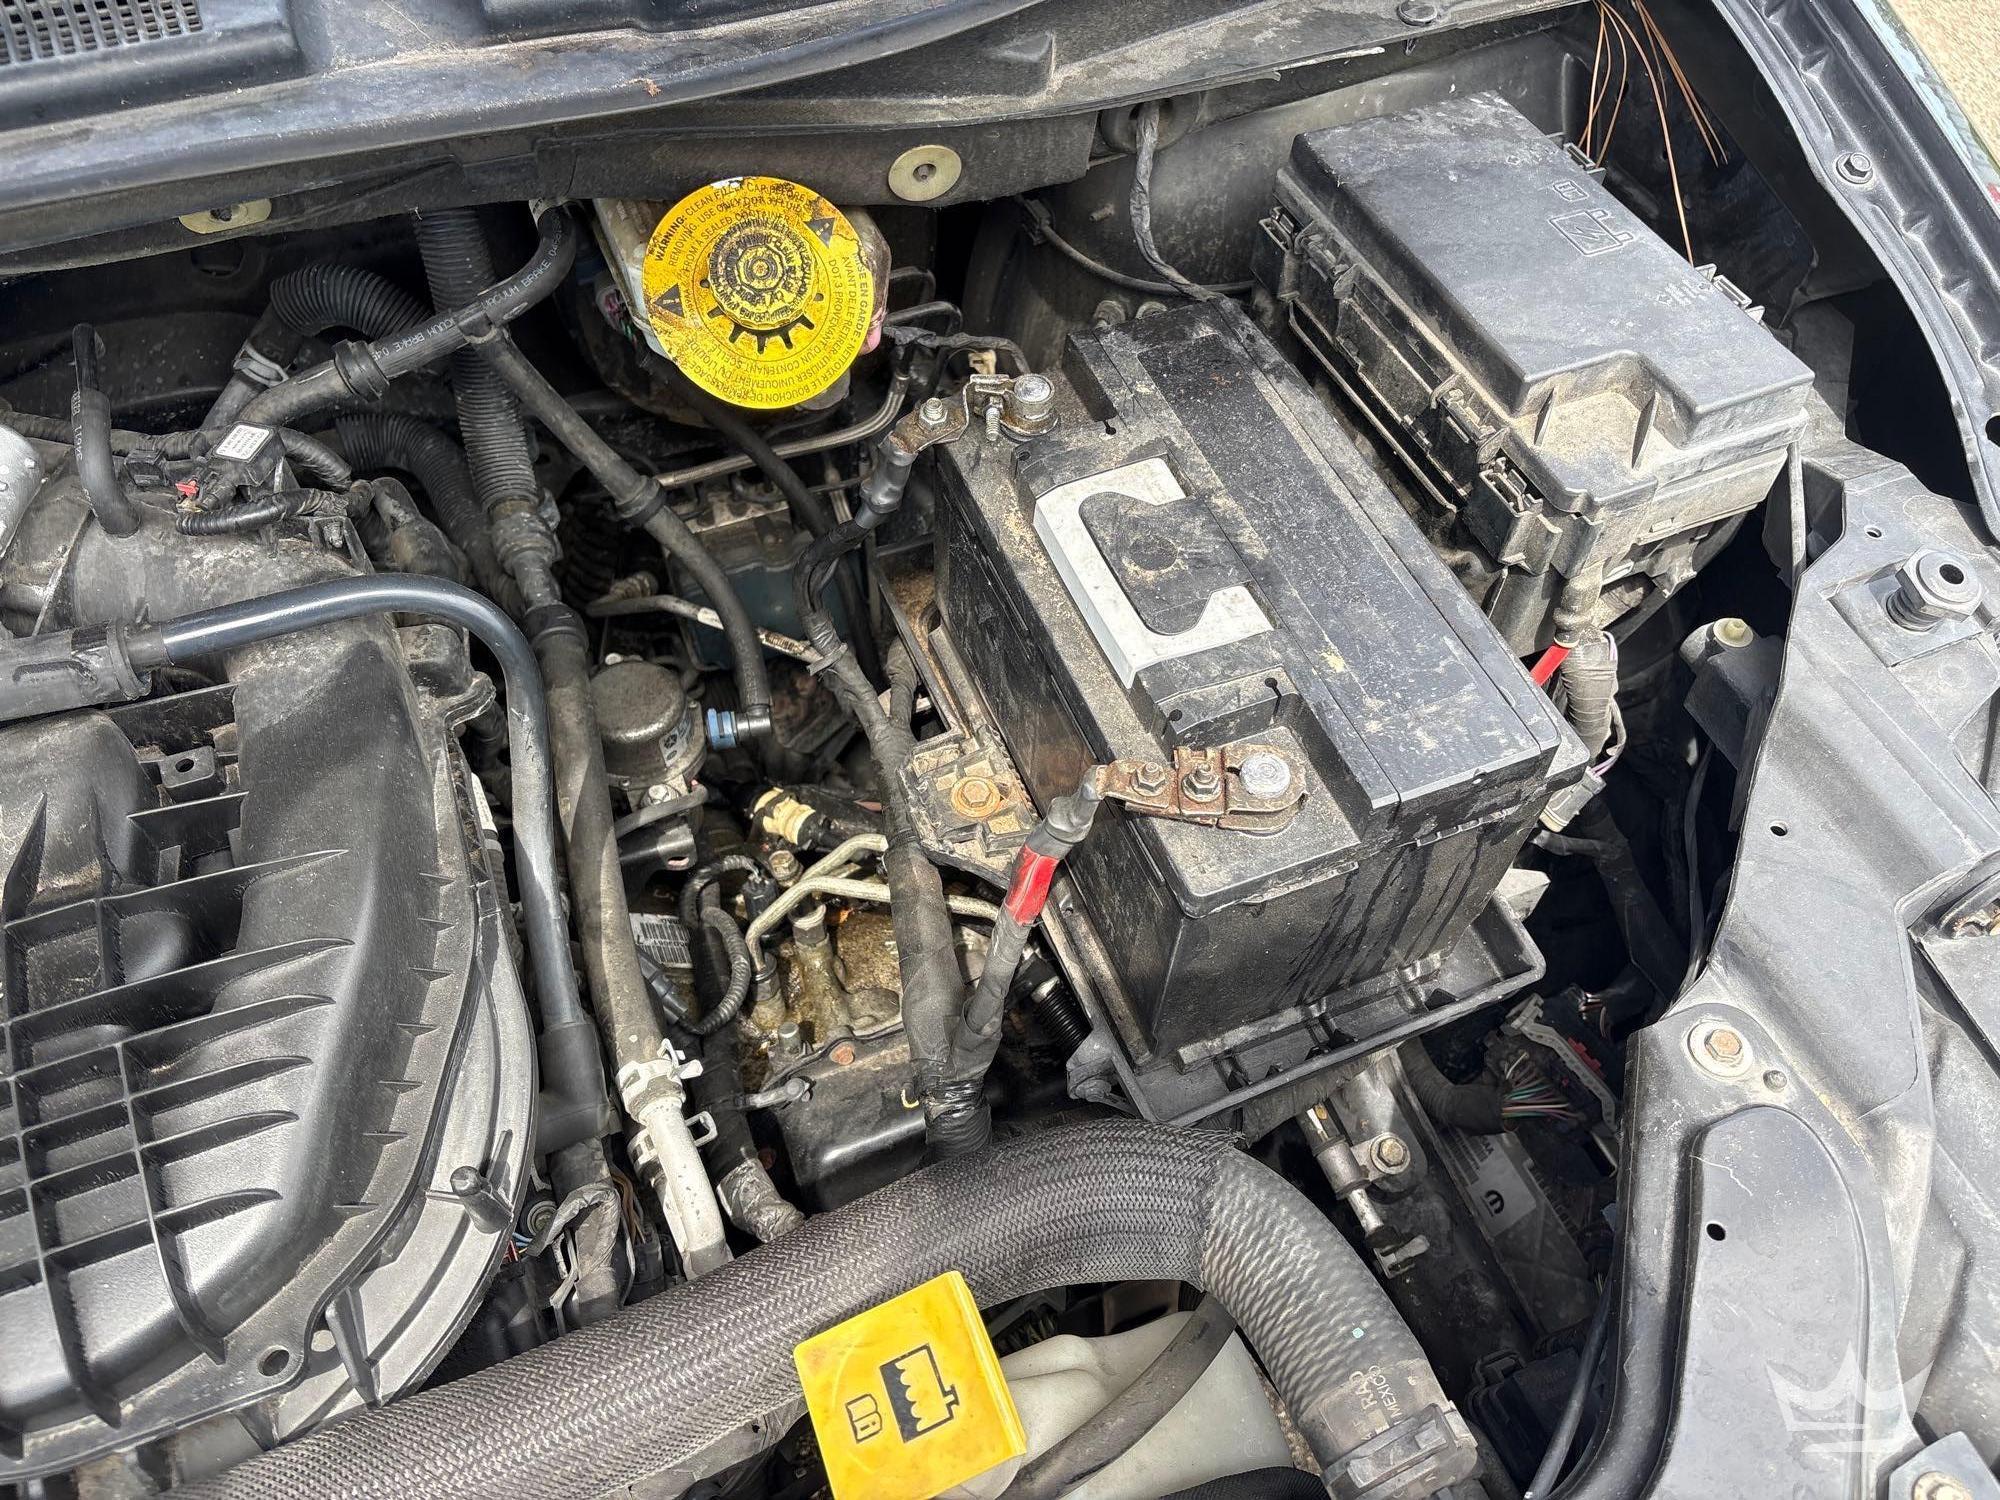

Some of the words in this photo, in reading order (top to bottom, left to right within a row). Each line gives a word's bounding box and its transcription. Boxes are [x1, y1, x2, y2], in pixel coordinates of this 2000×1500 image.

[655, 215, 687, 261] WARNING:
[685, 195, 714, 216] CLEAN
[747, 182, 766, 192] CAP
[697, 208, 717, 223] USE
[683, 246, 699, 273] FROM
[700, 216, 733, 240] SEALED
[521, 261, 551, 287] BRAKE
[828, 259, 842, 280] DOT
[842, 256, 856, 288] AVANT
[848, 291, 857, 304] DE
[860, 284, 868, 298] EN
[821, 292, 843, 348] PROVENANT
[846, 305, 855, 318] LE
[393, 332, 424, 353] BRAKE
[686, 338, 718, 370] LIQUIDE
[744, 360, 799, 375] CONTENANT
[796, 355, 830, 381] UTILISER
[822, 344, 855, 381] NETTOYER
[766, 385, 810, 402] BOUCHON
[811, 379, 823, 390] LE
[1368, 1365, 1402, 1418] MEXICO
